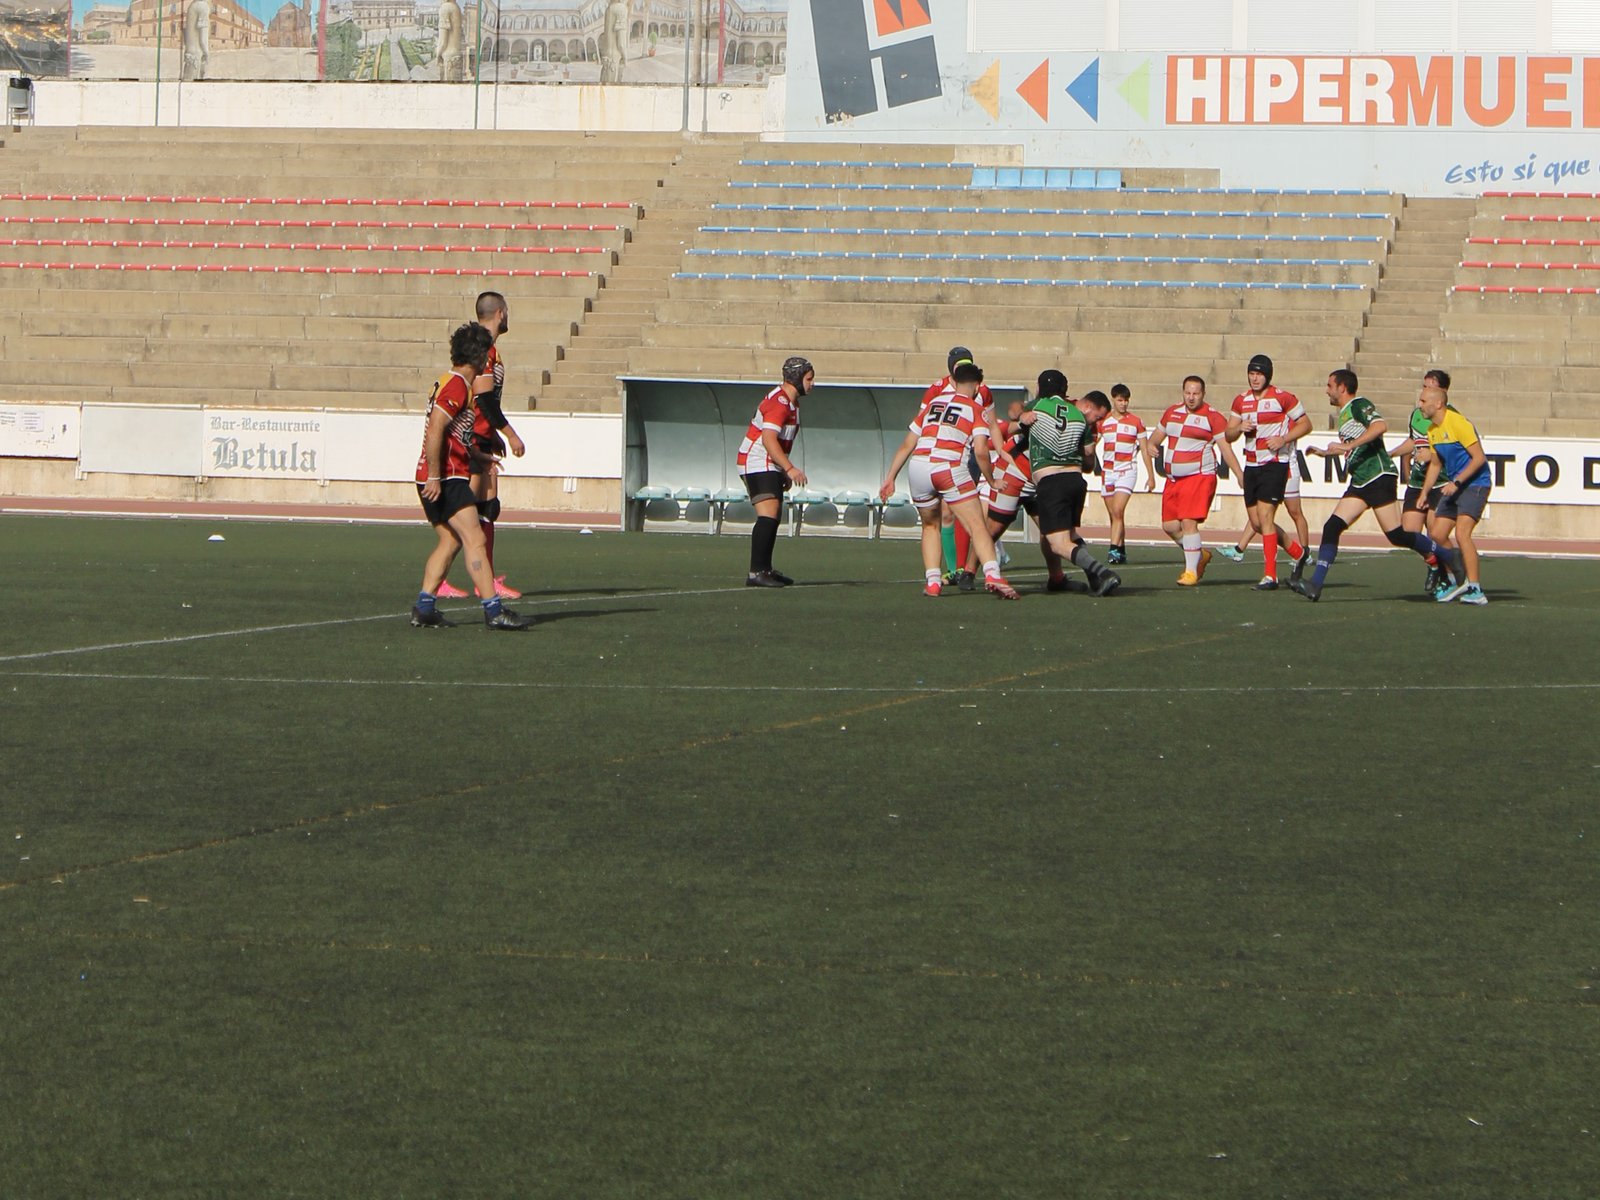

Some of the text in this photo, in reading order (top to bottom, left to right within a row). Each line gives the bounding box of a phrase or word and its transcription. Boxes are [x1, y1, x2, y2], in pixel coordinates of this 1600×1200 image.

[1445, 159, 1504, 184] Esto
[1511, 153, 1537, 181] si
[1543, 159, 1591, 186] que
[210, 416, 321, 433] Bar-Restaurante
[926, 403, 962, 426] 56
[1054, 403, 1069, 432] 5
[211, 436, 317, 472] Betula
